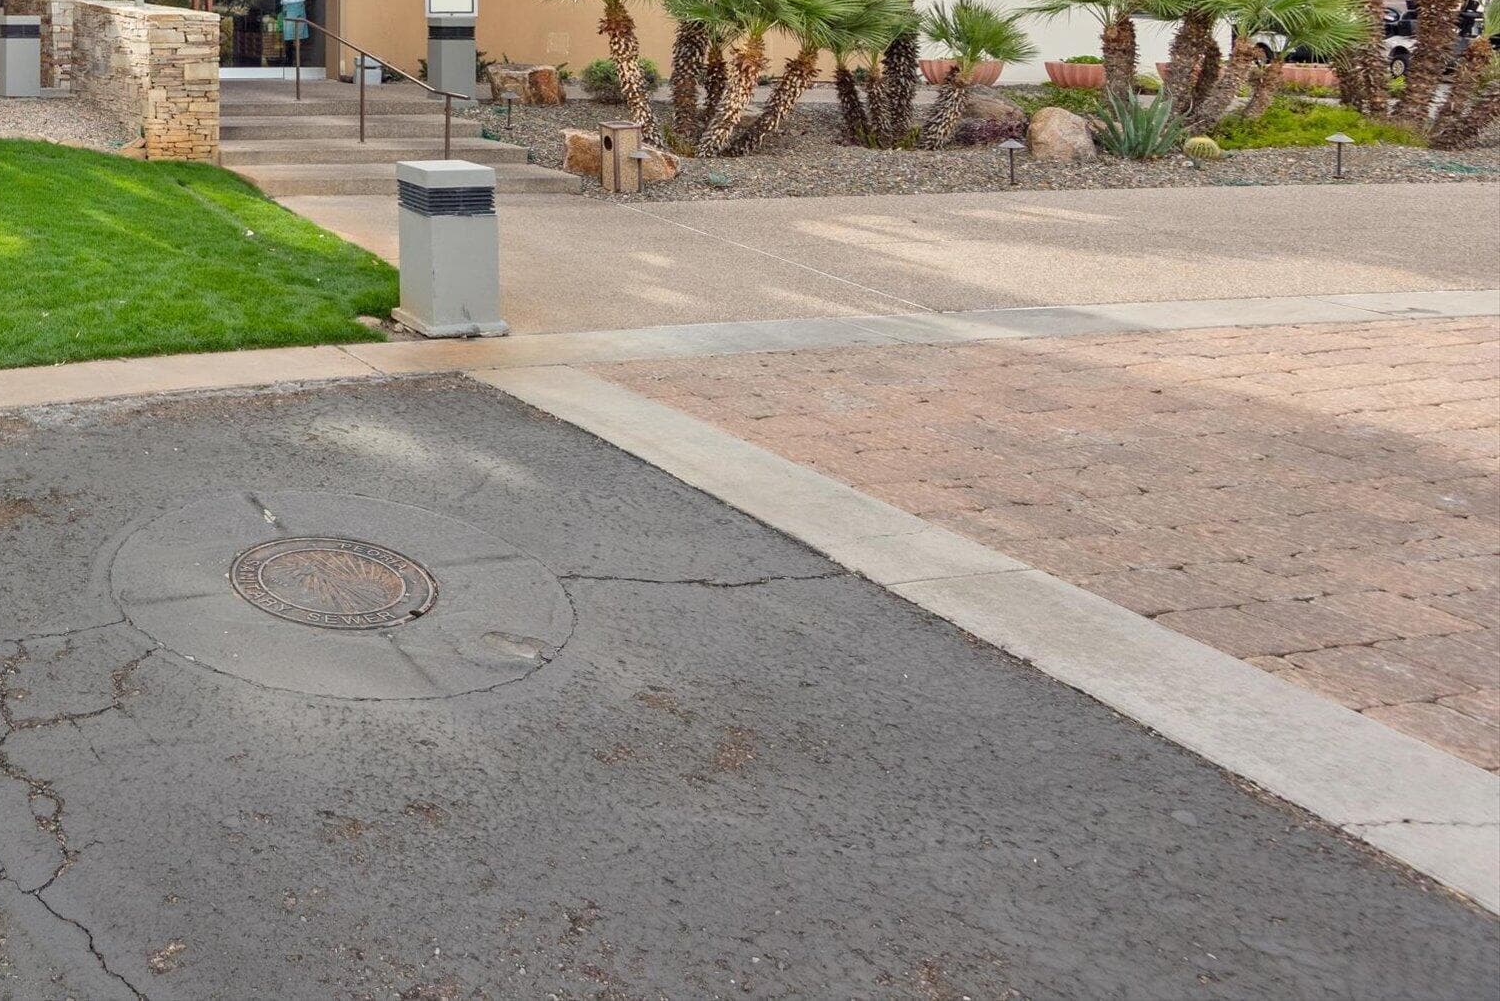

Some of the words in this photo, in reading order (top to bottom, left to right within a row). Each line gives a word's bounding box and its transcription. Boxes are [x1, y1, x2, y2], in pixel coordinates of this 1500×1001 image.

[340, 543, 407, 570] PEORIA
[239, 559, 293, 612] SANITARY
[306, 611, 396, 625] SEWER
